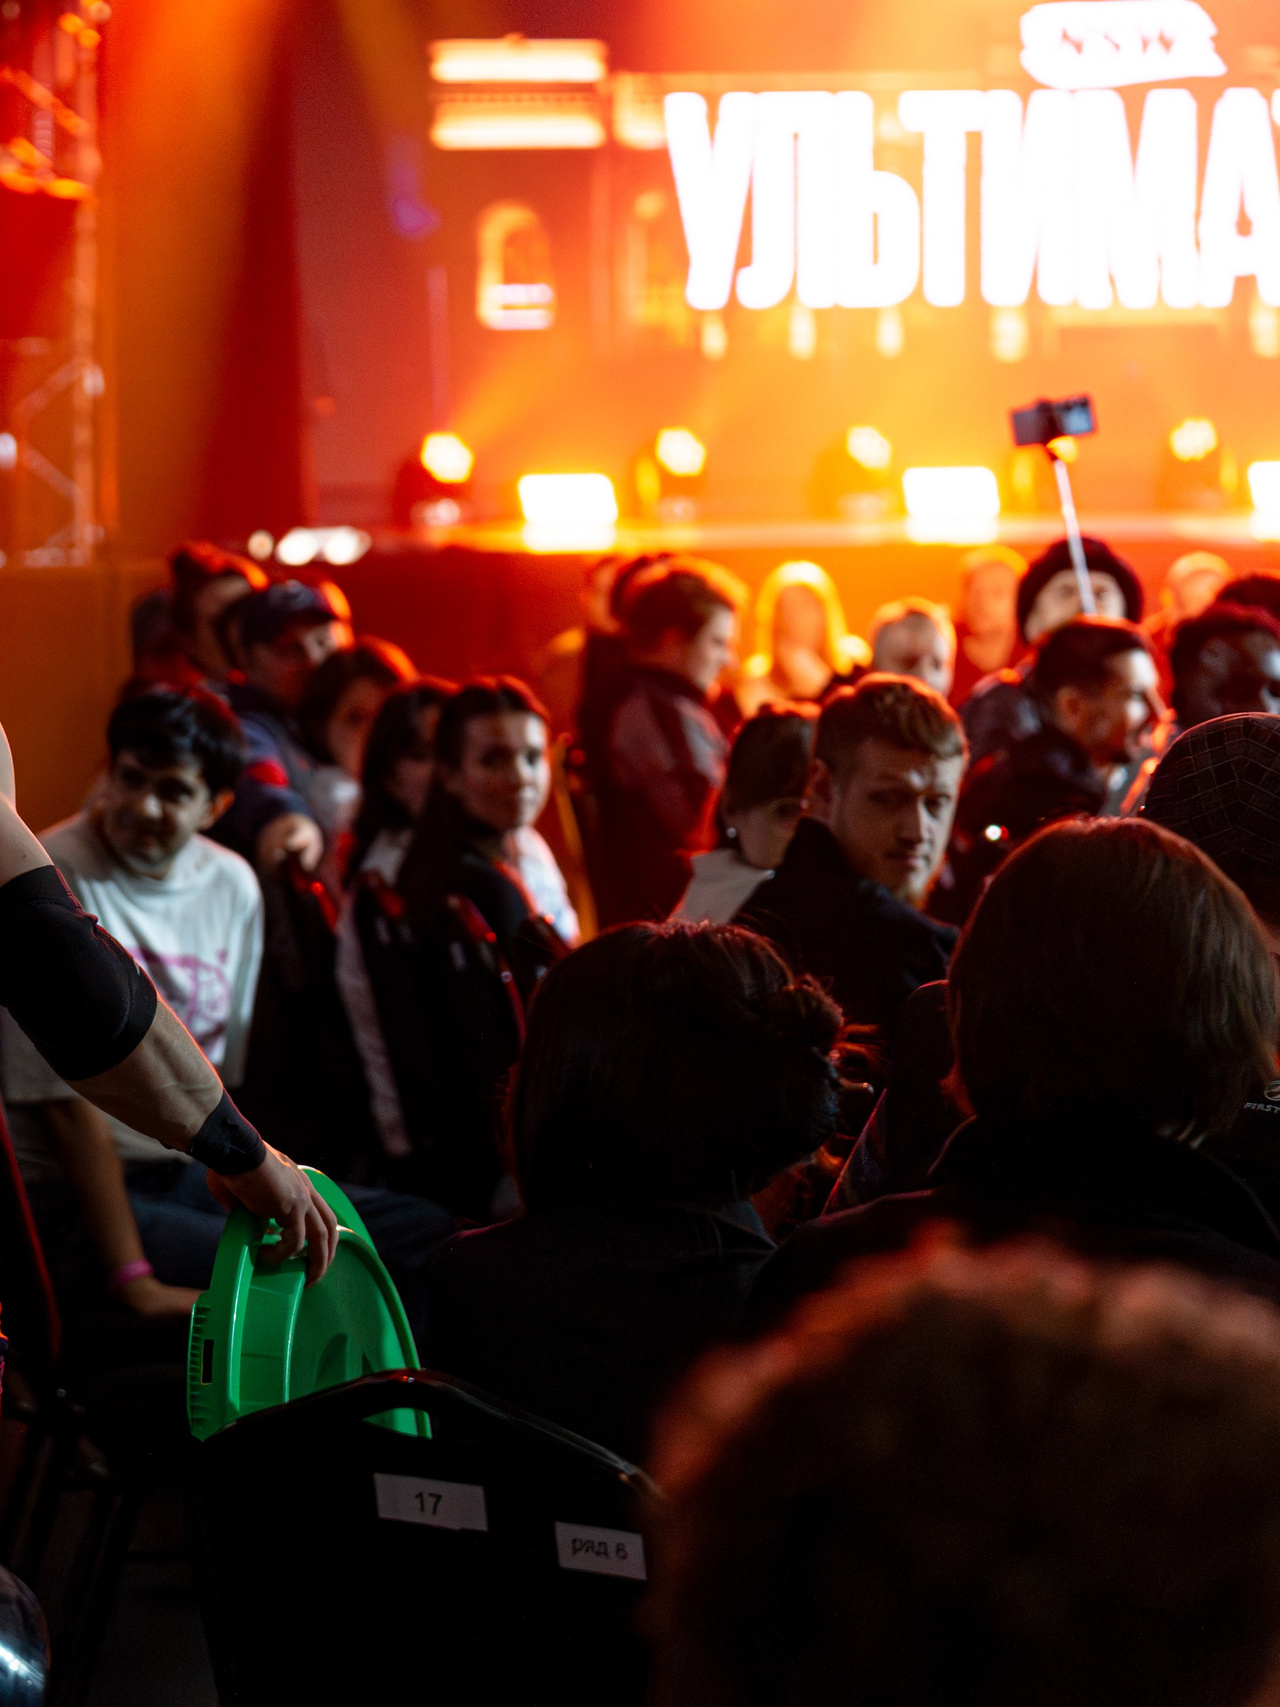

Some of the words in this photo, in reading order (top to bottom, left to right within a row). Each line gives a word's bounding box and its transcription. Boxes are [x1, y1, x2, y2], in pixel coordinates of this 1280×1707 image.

[664, 87, 1280, 309] УЛЬТИМА
[414, 1491, 442, 1515] 17
[571, 1537, 609, 1557] ряд
[615, 1542, 628, 1560] 6
